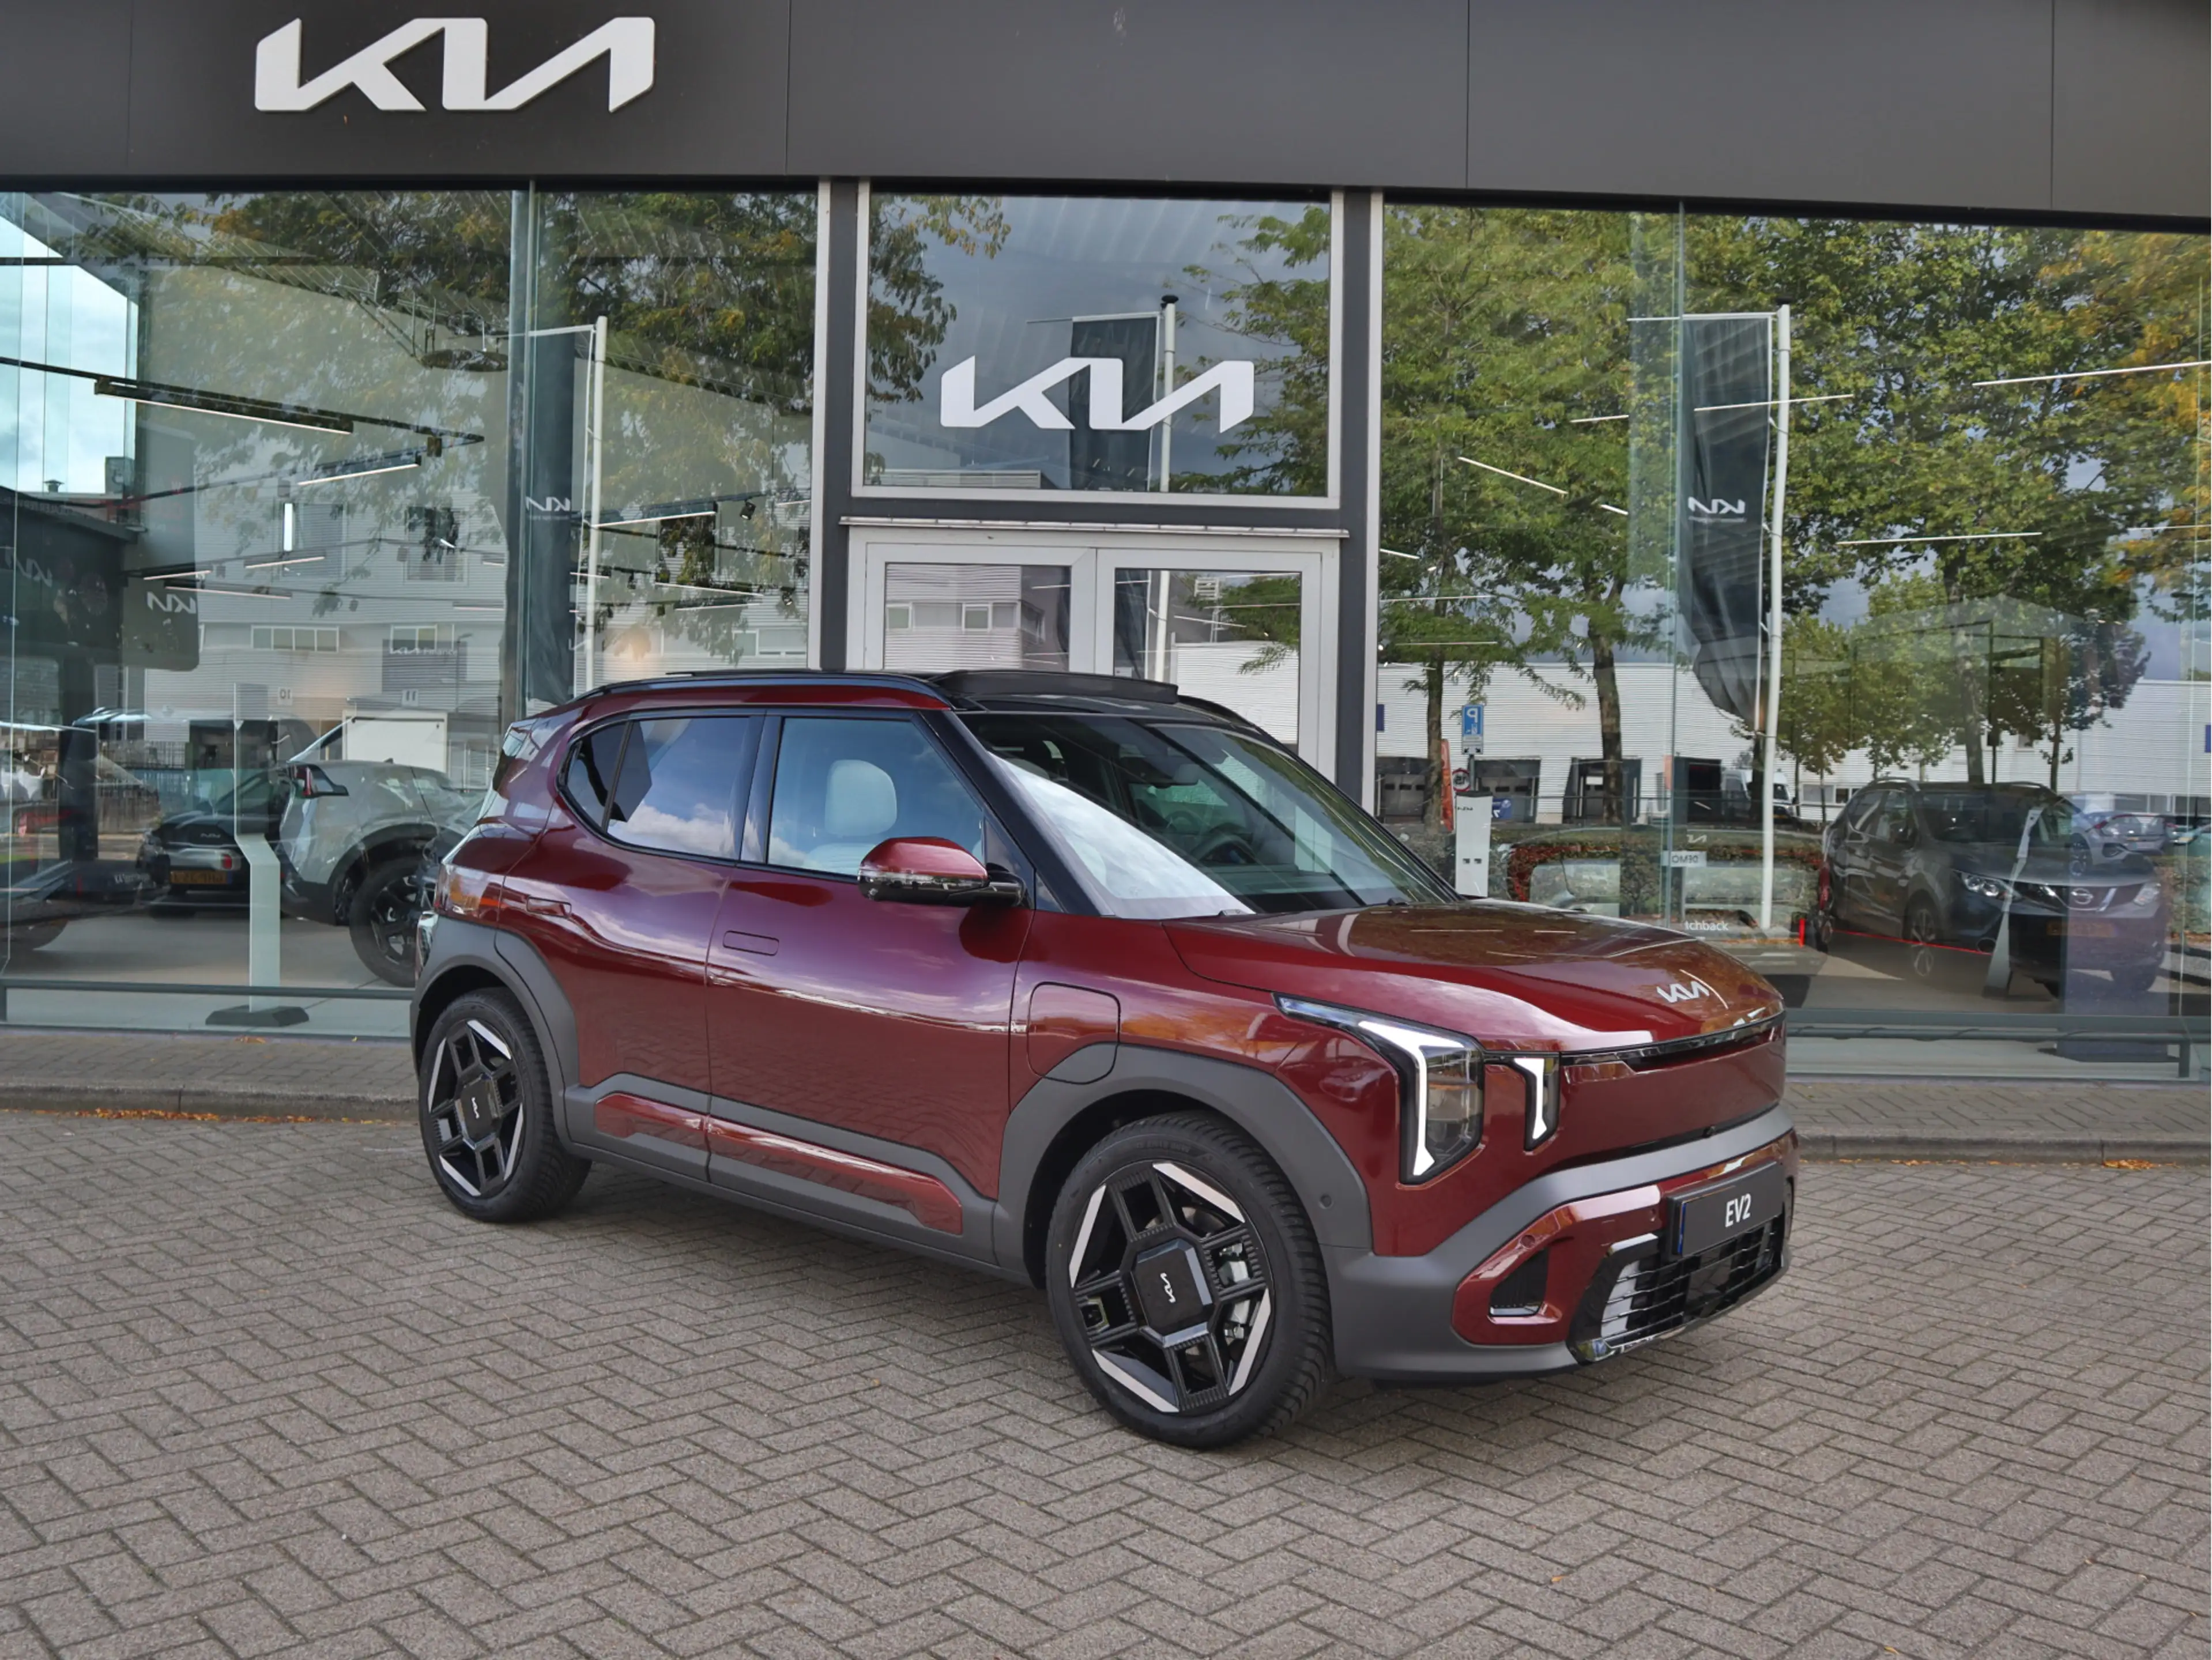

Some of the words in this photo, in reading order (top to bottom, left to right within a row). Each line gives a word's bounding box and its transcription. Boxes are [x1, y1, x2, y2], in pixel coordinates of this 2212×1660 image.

[255, 17, 655, 112] KIA
[940, 355, 1254, 433] KIA
[1656, 980, 1709, 1003] KIA
[1725, 1193, 1751, 1228] EV2
